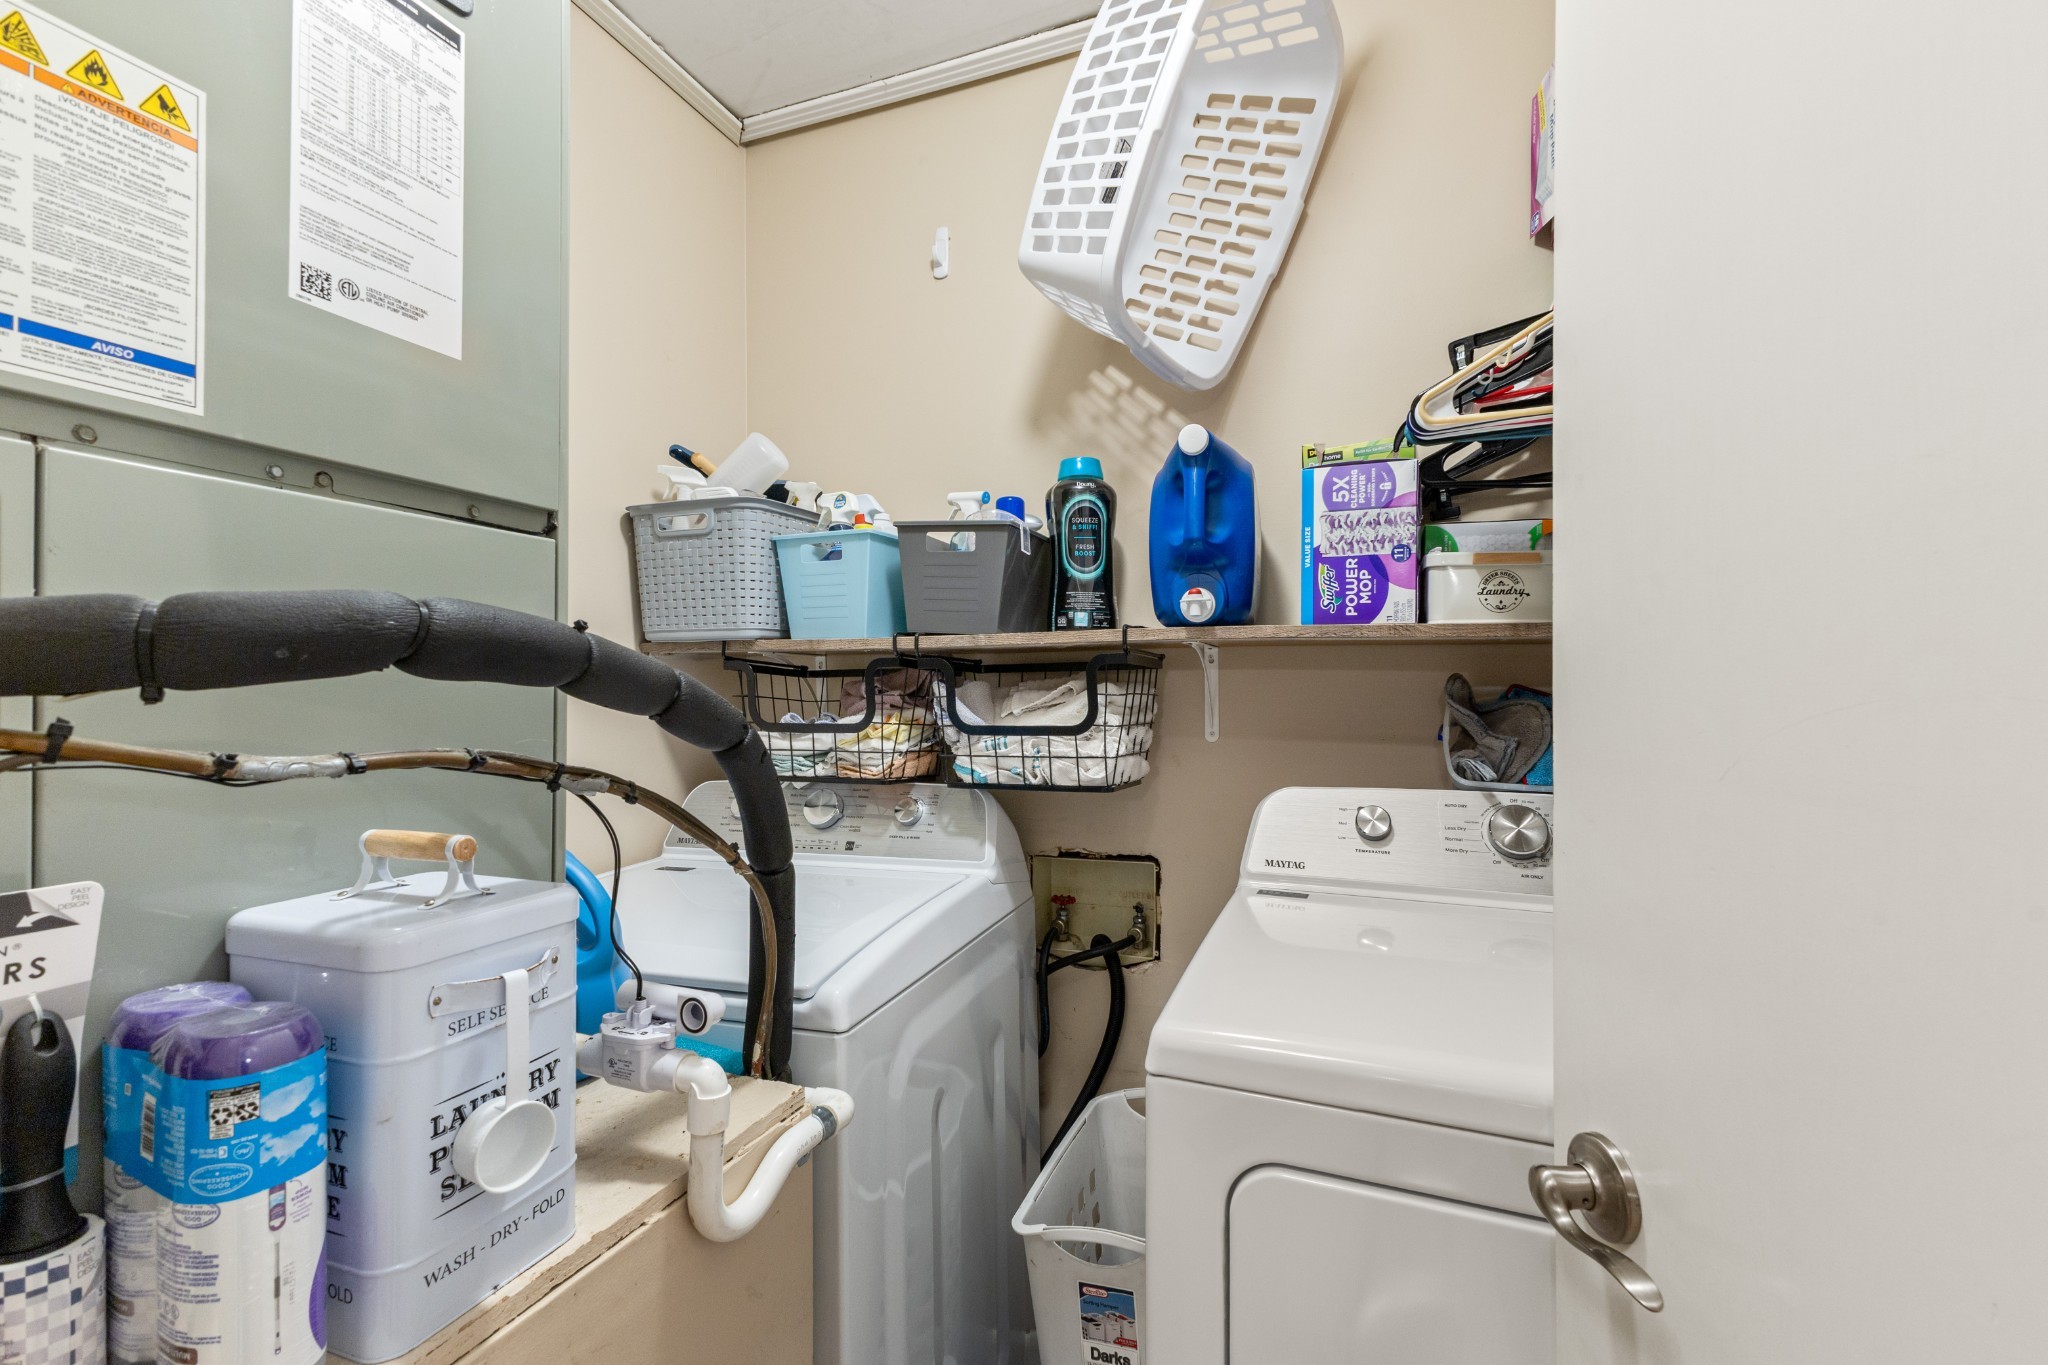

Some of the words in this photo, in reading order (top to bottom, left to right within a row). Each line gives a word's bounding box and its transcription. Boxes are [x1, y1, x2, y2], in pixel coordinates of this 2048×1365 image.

[77, 87, 171, 138] ADVERTENCIA
[91, 339, 134, 360] AVISO
[1077, 481, 1095, 489] Downy
[1333, 475, 1350, 502] 5X
[1394, 548, 1403, 559] 11
[1346, 558, 1358, 616] POWER
[1360, 569, 1372, 604] MOP
[1482, 572, 1499, 586] DRYER
[1500, 571, 1520, 585] SHEETS
[1321, 566, 1339, 613] Swiffer
[1477, 586, 1526, 597] Laundry
[1265, 859, 1306, 869] MAYTAG
[70, 887, 92, 895] EASY
[58, 900, 90, 912] DESIGN
[447, 1011, 486, 1037] SELF
[424, 1246, 475, 1288] WASH
[490, 1216, 521, 1248] DRY
[532, 1188, 565, 1220] FOLD
[77, 1246, 96, 1262] EASY
[327, 1283, 353, 1304] OLD
[1090, 1346, 1131, 1365] Darks
